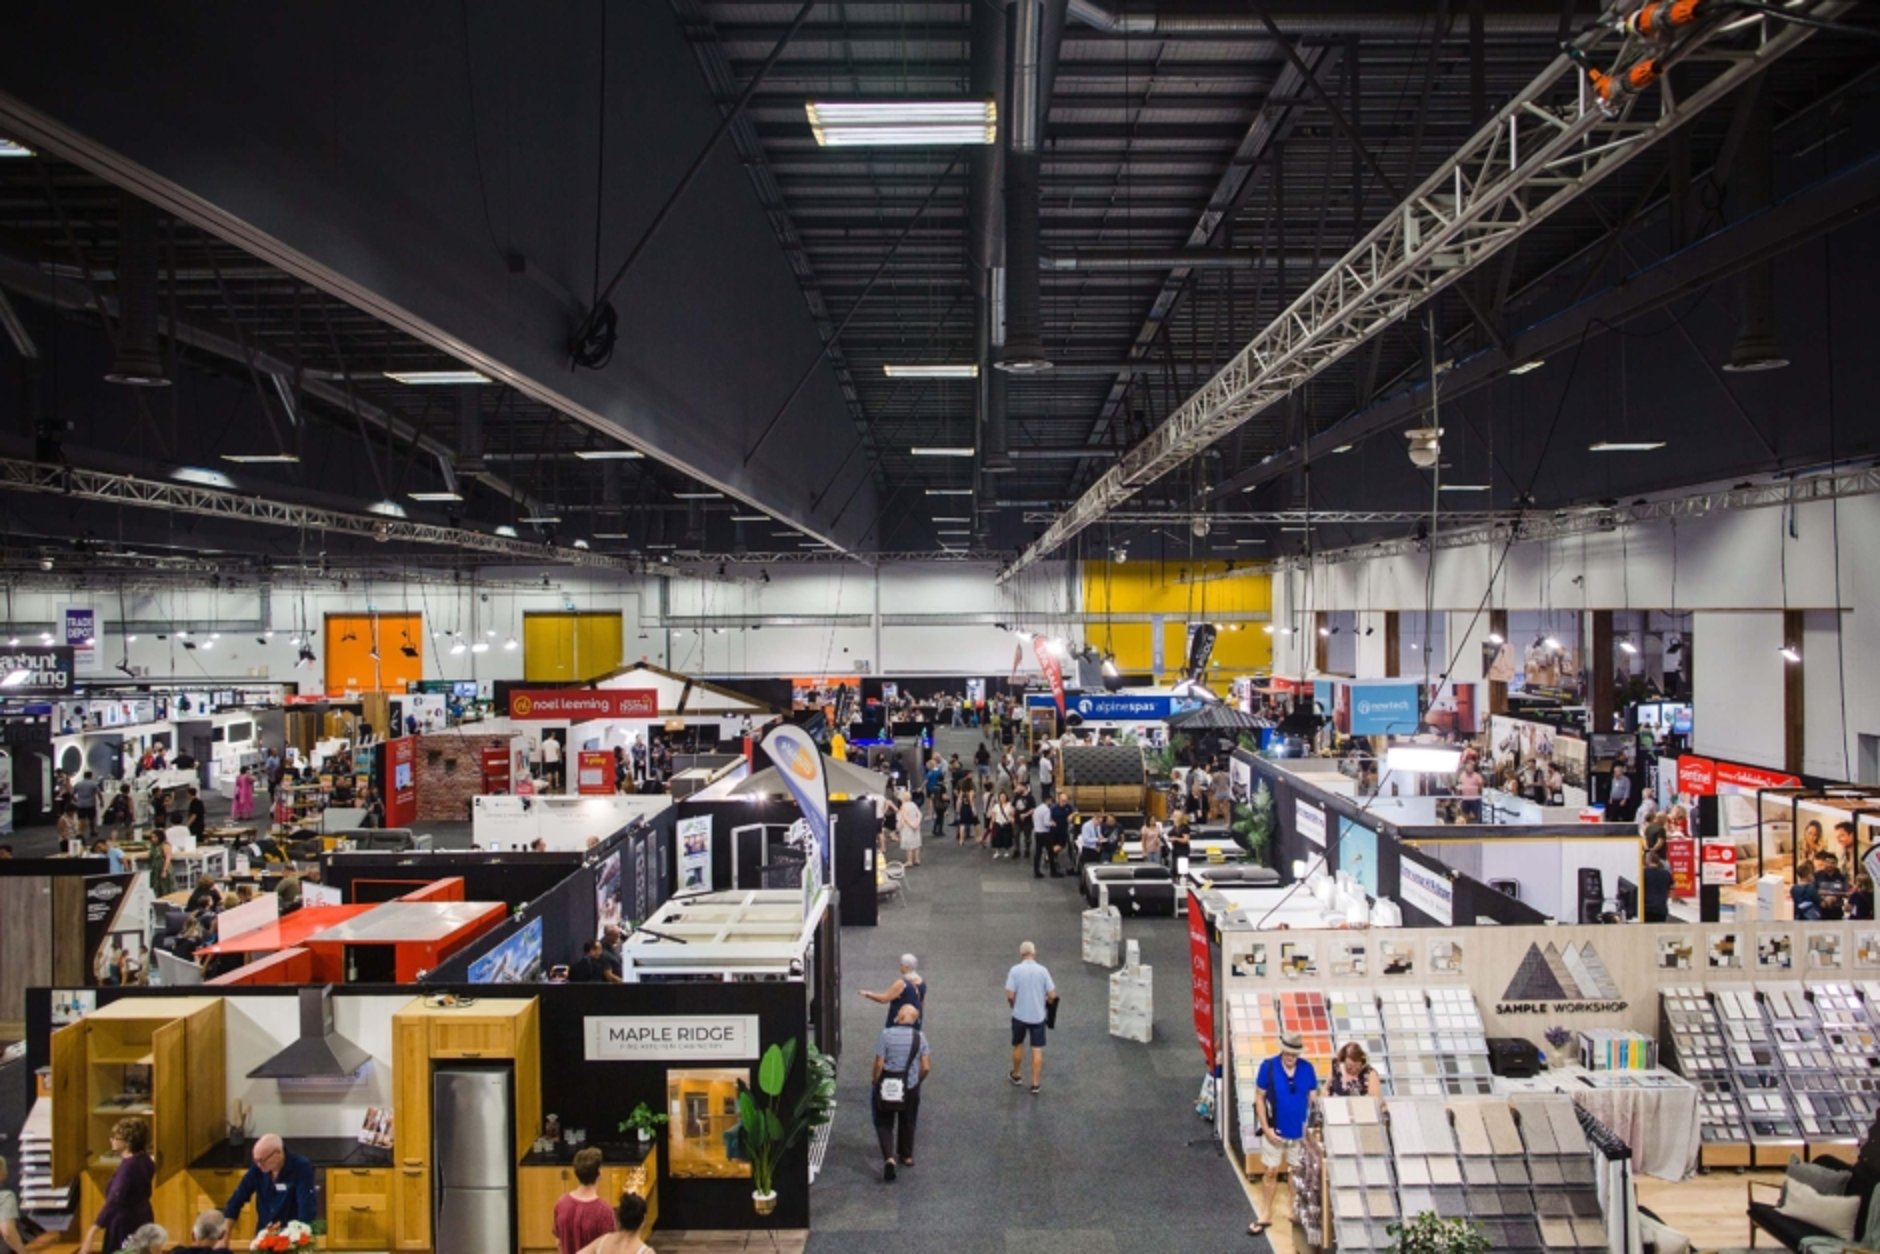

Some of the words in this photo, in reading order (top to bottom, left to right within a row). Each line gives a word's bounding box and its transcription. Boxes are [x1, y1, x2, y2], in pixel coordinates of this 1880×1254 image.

[67, 628, 93, 639] DEPOT
[533, 699, 560, 710] noel
[562, 698, 609, 712] leeming
[1095, 701, 1155, 716] alpinespas
[1680, 769, 1712, 784] sentinel
[1495, 1003, 1547, 1014] SAMPLE
[1553, 1001, 1629, 1013] WORKSHOP
[609, 1027, 672, 1042] MAPLE
[677, 1026, 735, 1041] RIDGE
